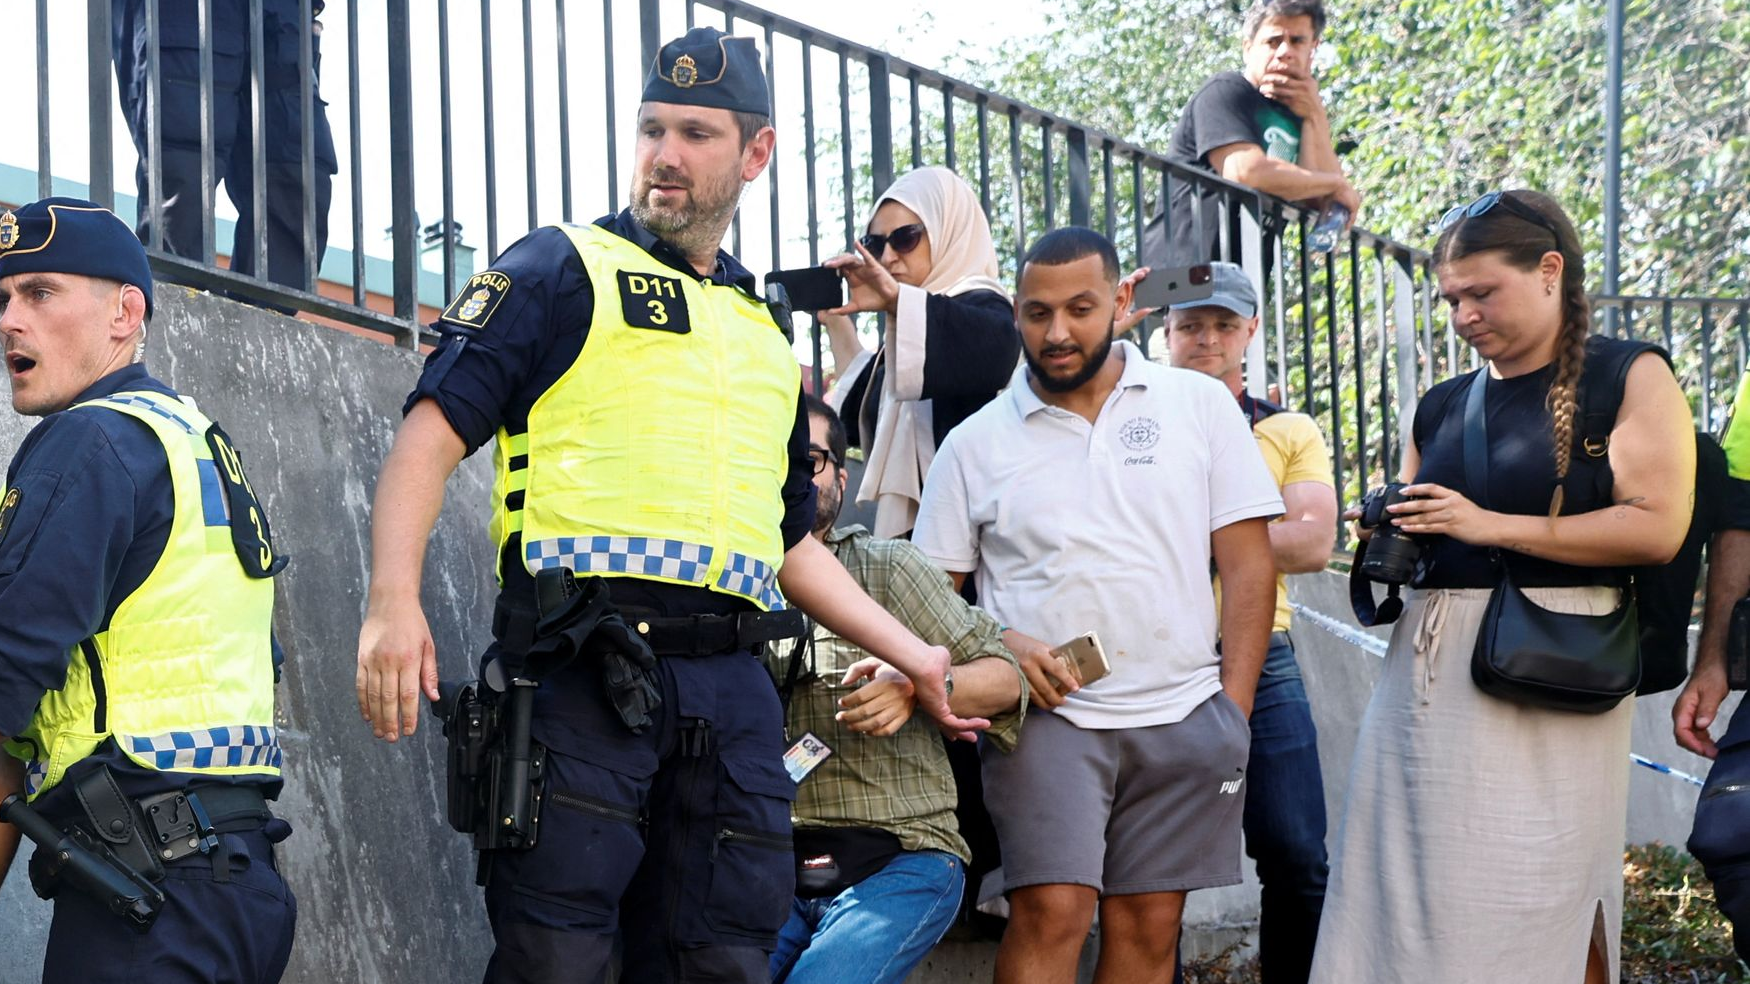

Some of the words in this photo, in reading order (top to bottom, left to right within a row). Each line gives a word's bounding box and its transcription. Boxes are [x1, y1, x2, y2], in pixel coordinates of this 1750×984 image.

[472, 274, 508, 292] POLIS
[628, 275, 676, 299] D11
[647, 299, 669, 325] 3
[249, 506, 272, 571] 3
